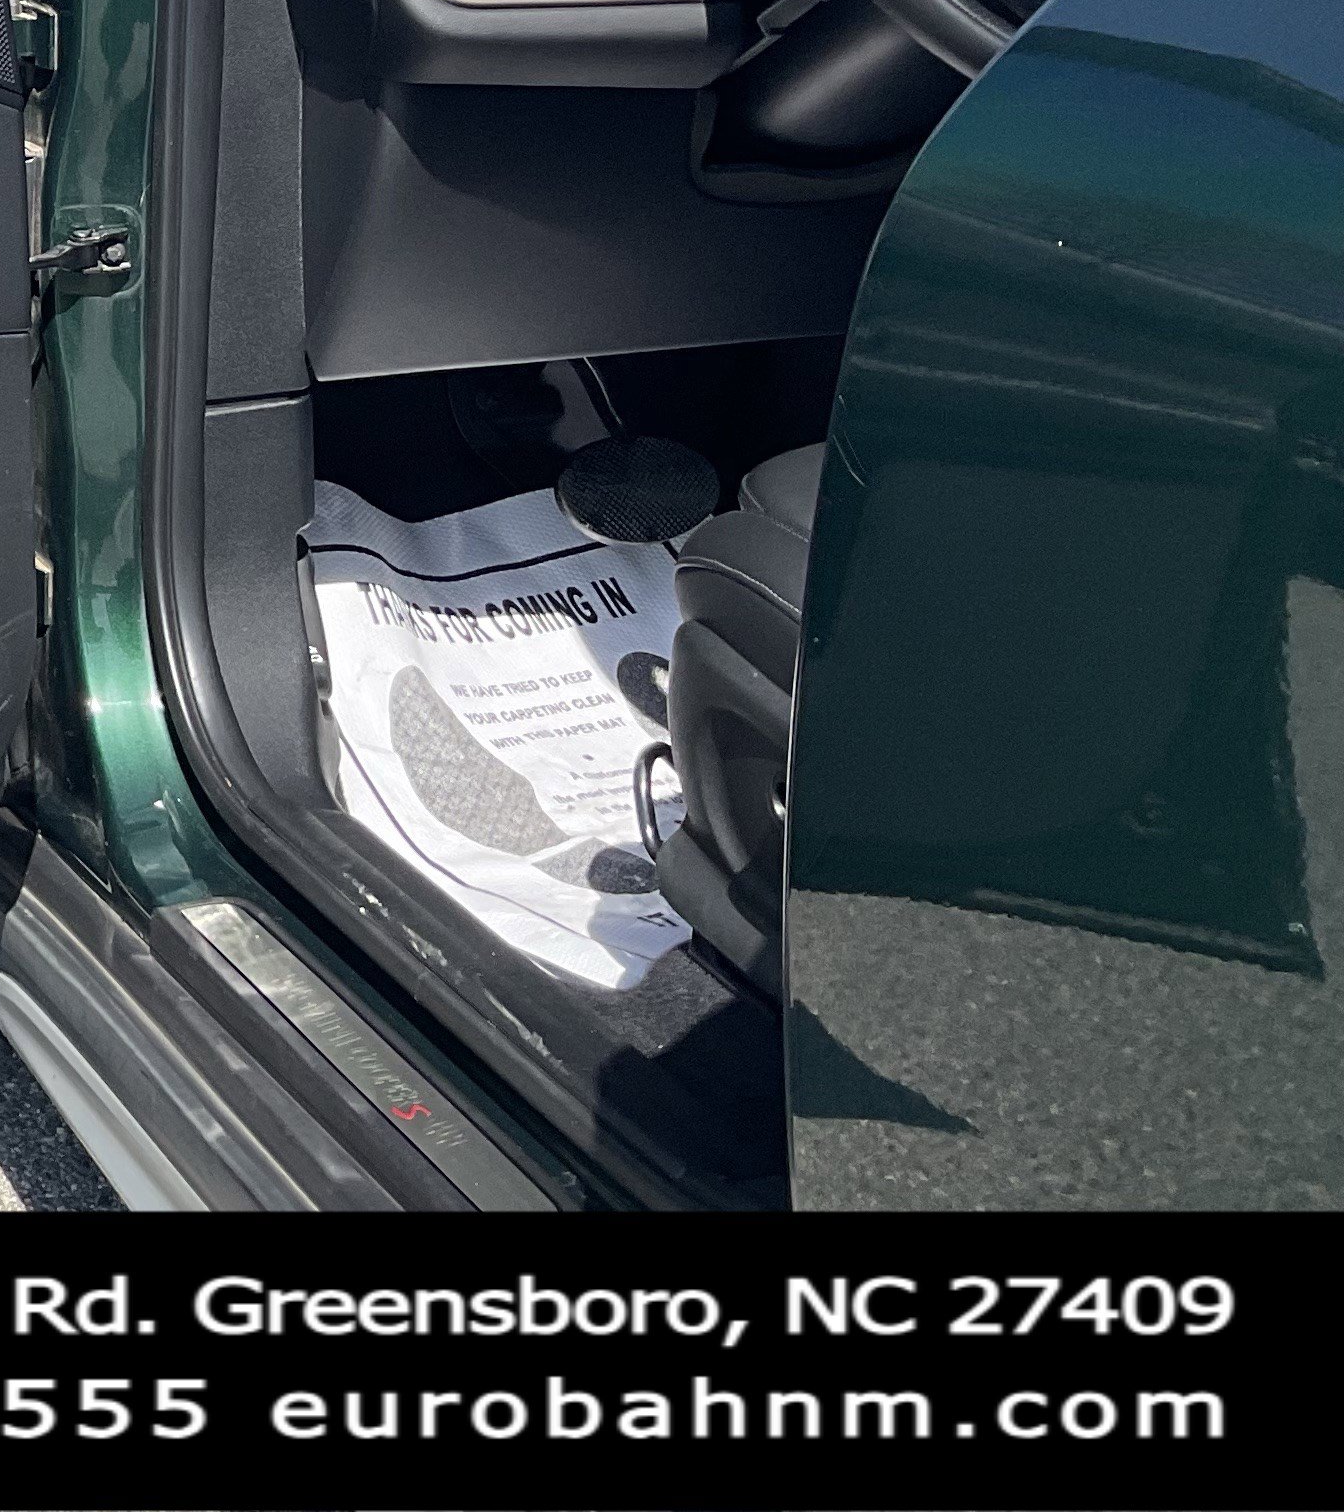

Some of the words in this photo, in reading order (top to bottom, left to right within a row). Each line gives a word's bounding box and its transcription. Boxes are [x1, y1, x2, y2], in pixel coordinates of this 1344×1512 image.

[429, 605, 494, 644] FOR
[485, 586, 599, 639] COMING
[591, 577, 637, 618] IN
[469, 685, 503, 698] HAVE
[502, 680, 540, 696] TRIED
[539, 676, 560, 689] TO
[559, 669, 593, 685] KEEP
[464, 712, 501, 725] YOUR
[500, 700, 572, 723] CARPETING
[571, 693, 616, 710] CLEAN
[489, 737, 527, 750] WITH
[553, 722, 599, 737] PAPER
[597, 717, 628, 730] MAT
